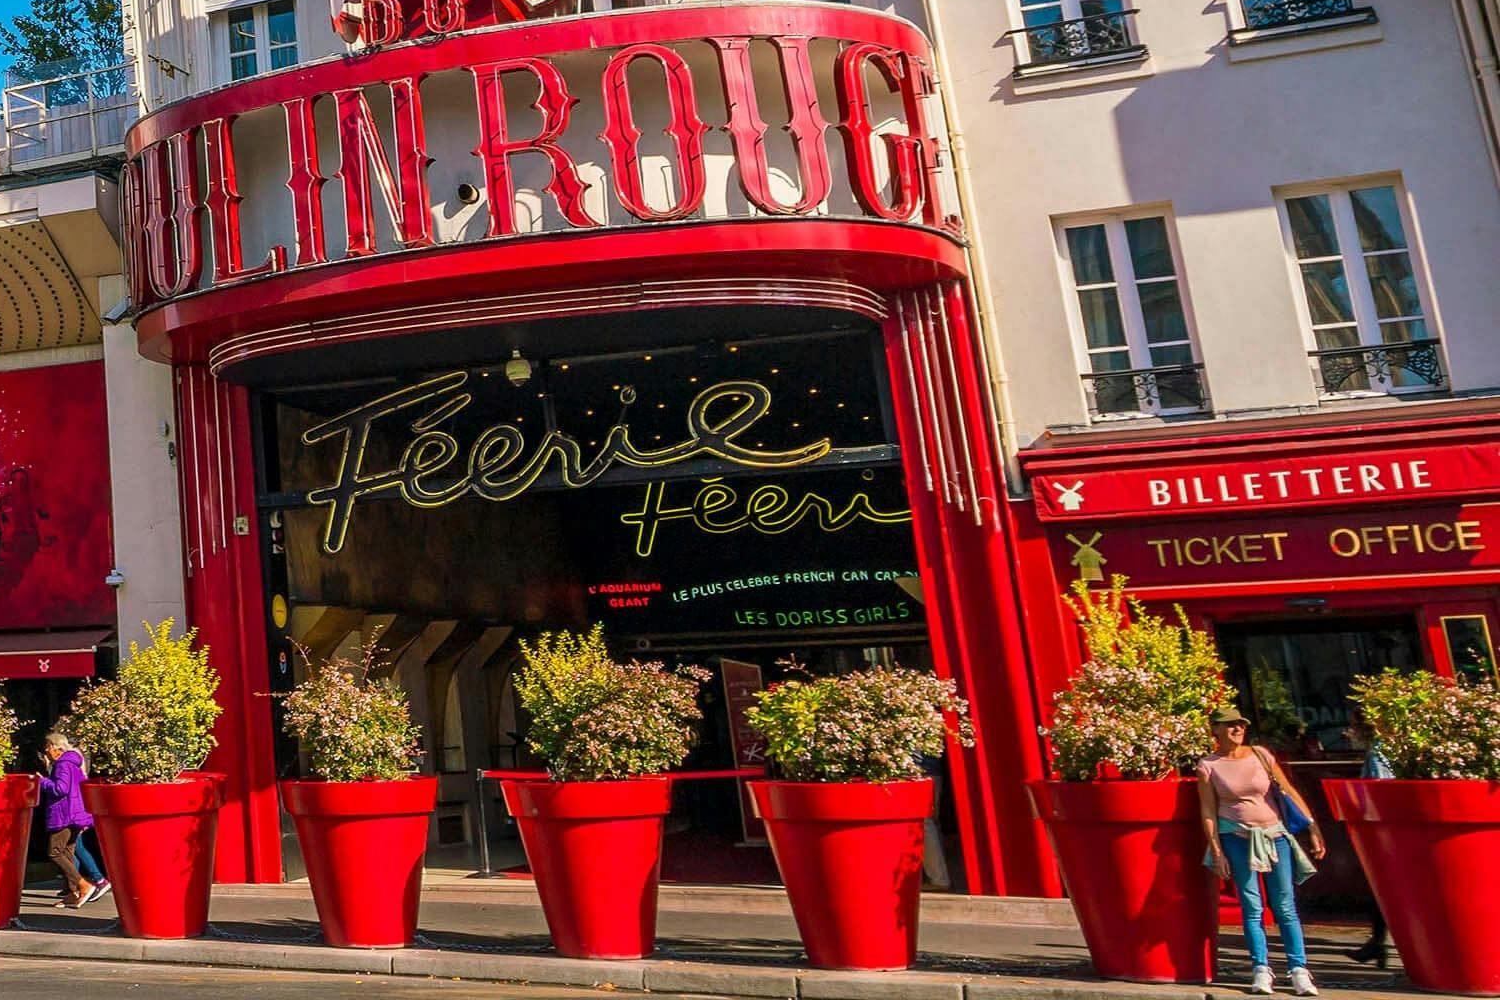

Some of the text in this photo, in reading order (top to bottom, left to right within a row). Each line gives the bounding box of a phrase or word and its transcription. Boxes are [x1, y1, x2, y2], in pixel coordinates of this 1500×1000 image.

[118, 74, 437, 308] OULIN
[302, 370, 831, 555] Féerie
[1148, 460, 1432, 506] BILLETTERIE
[620, 468, 913, 557] Féeri
[1148, 521, 1486, 567] TICKET OFFICE
[672, 589, 689, 602] LE
[691, 583, 724, 599] PLUS
[785, 570, 835, 583] FRENCH
[842, 570, 869, 582] CAN
[735, 602, 910, 626] LES DORISS GIRLS
